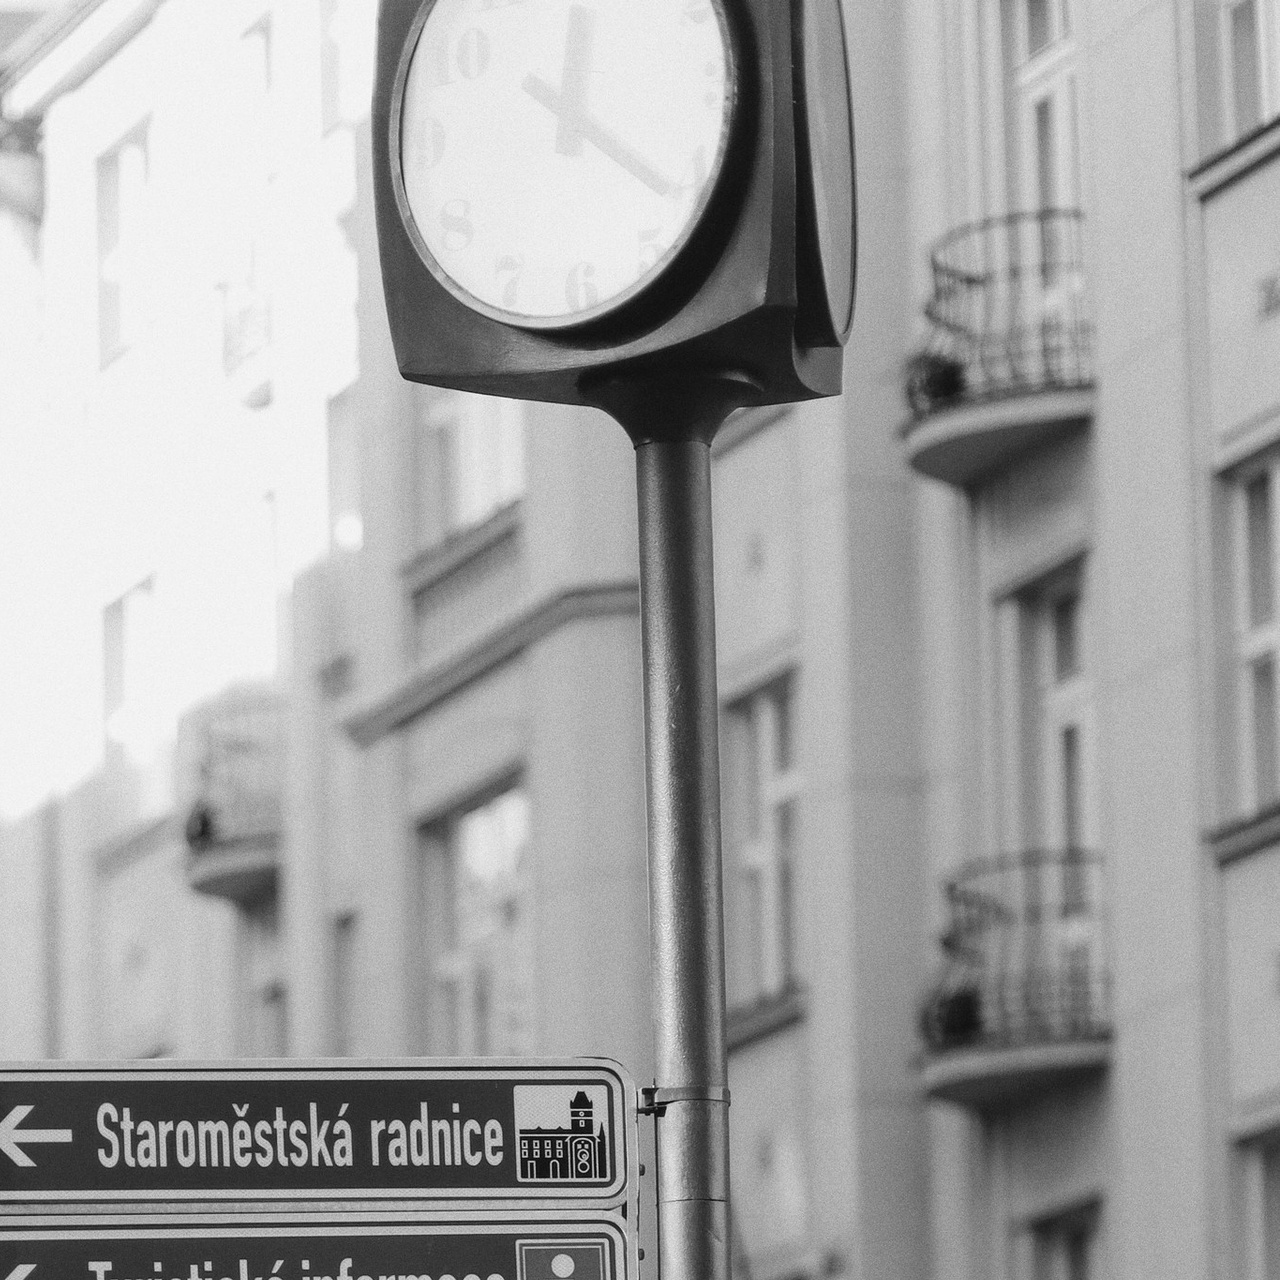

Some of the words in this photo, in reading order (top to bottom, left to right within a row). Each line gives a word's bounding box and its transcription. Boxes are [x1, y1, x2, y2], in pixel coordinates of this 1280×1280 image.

[439, 199, 475, 252] 8
[494, 254, 525, 307] 7
[564, 261, 599, 312] 6
[96, 1101, 353, 1168] Staroměstská
[370, 1101, 504, 1168] radnice
